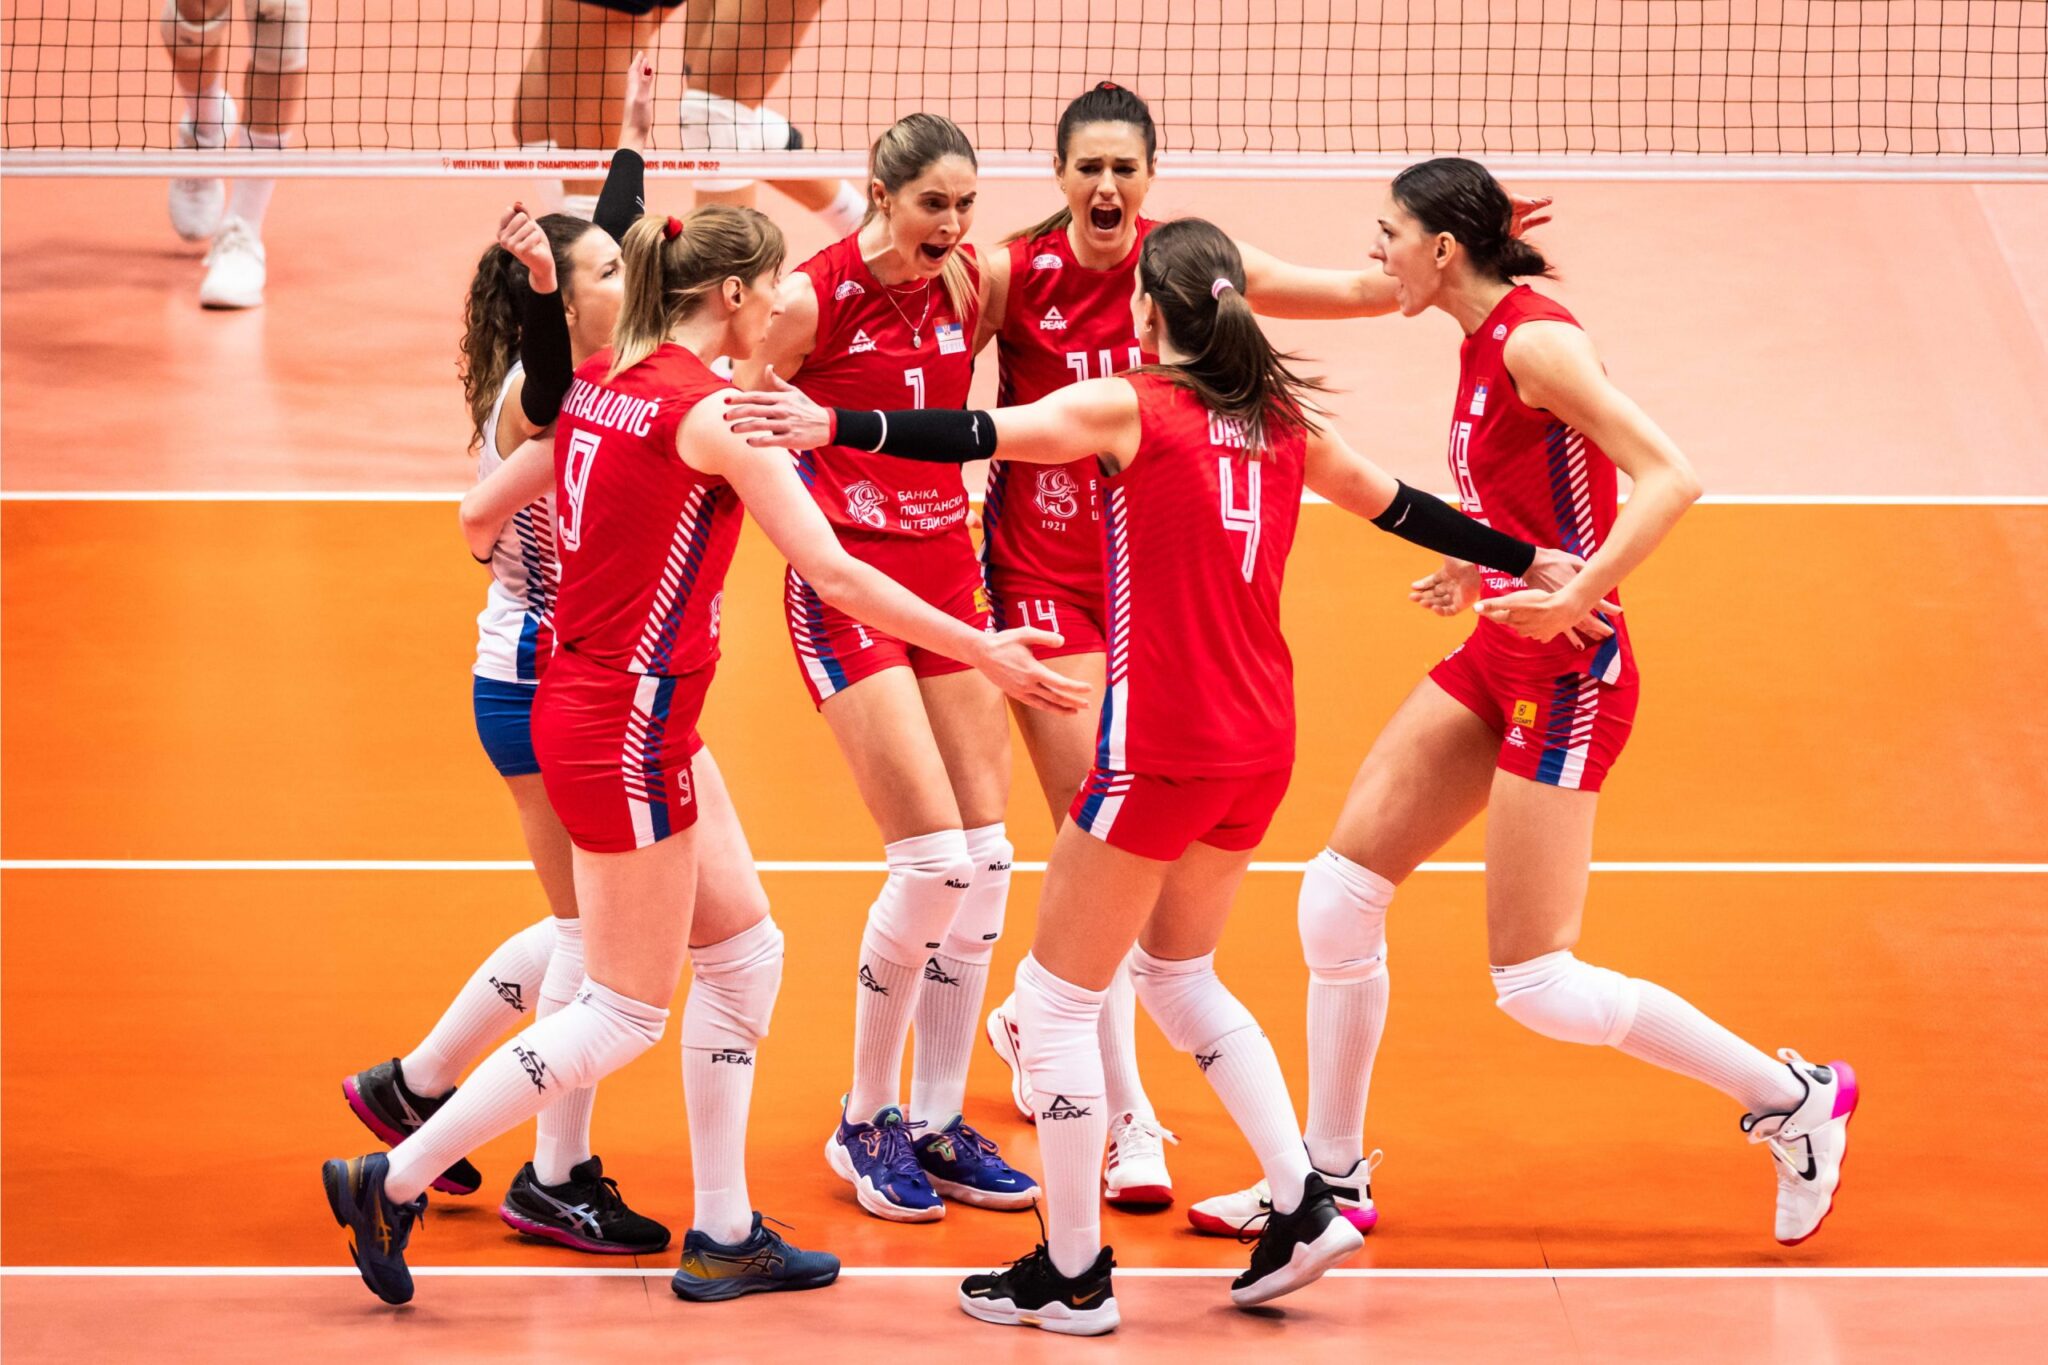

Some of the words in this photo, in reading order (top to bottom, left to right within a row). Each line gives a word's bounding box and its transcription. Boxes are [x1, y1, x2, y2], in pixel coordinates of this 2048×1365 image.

[453, 160, 500, 170] VOLLEYBALL
[503, 160, 535, 170] WORLD
[537, 160, 599, 170] CHAMPIONSHIP
[662, 161, 696, 171] POLAND
[698, 161, 720, 171] 2022
[1040, 320, 1067, 330] PEAK
[848, 341, 878, 354] PEAK
[559, 428, 602, 552] 9
[898, 489, 939, 502] БАНКА
[900, 495, 963, 516] ПОШТАНСКА
[1041, 519, 1066, 532] 1921
[1219, 456, 1262, 584] 4
[1017, 599, 1060, 633] 14
[488, 976, 527, 1013] PEAK
[711, 1053, 753, 1066] PEAK
[512, 1046, 547, 1095] PEAK
[1042, 1106, 1092, 1121] PEAK
